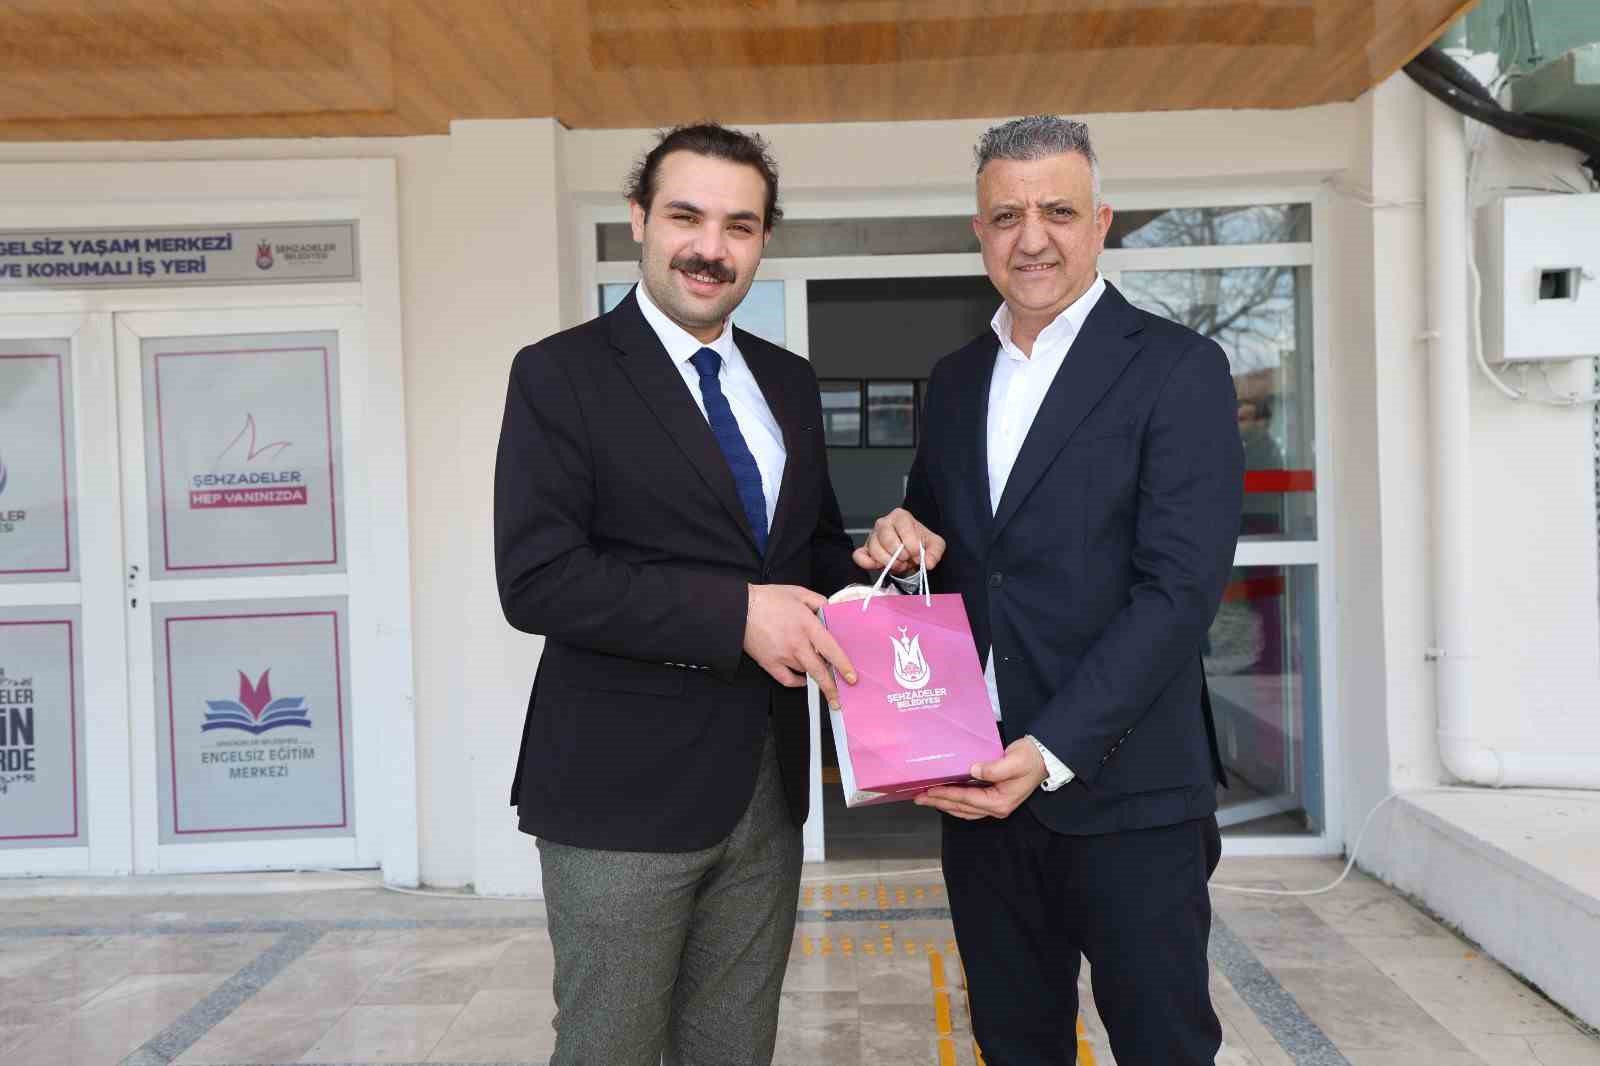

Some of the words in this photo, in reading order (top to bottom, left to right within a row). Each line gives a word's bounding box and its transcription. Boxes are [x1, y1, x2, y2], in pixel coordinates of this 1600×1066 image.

[68, 238, 140, 257] YAŞAM
[145, 232, 232, 252] MERKEZİ
[0, 263, 22, 278] VE
[27, 260, 132, 277] KORUMALI
[138, 257, 156, 278] İŞ
[161, 255, 206, 275] YERİ
[193, 494, 221, 505] HEP
[224, 489, 304, 504] YANINIZDA
[269, 745, 315, 761] EĞİTİM
[229, 762, 288, 779] MERKEZİ
